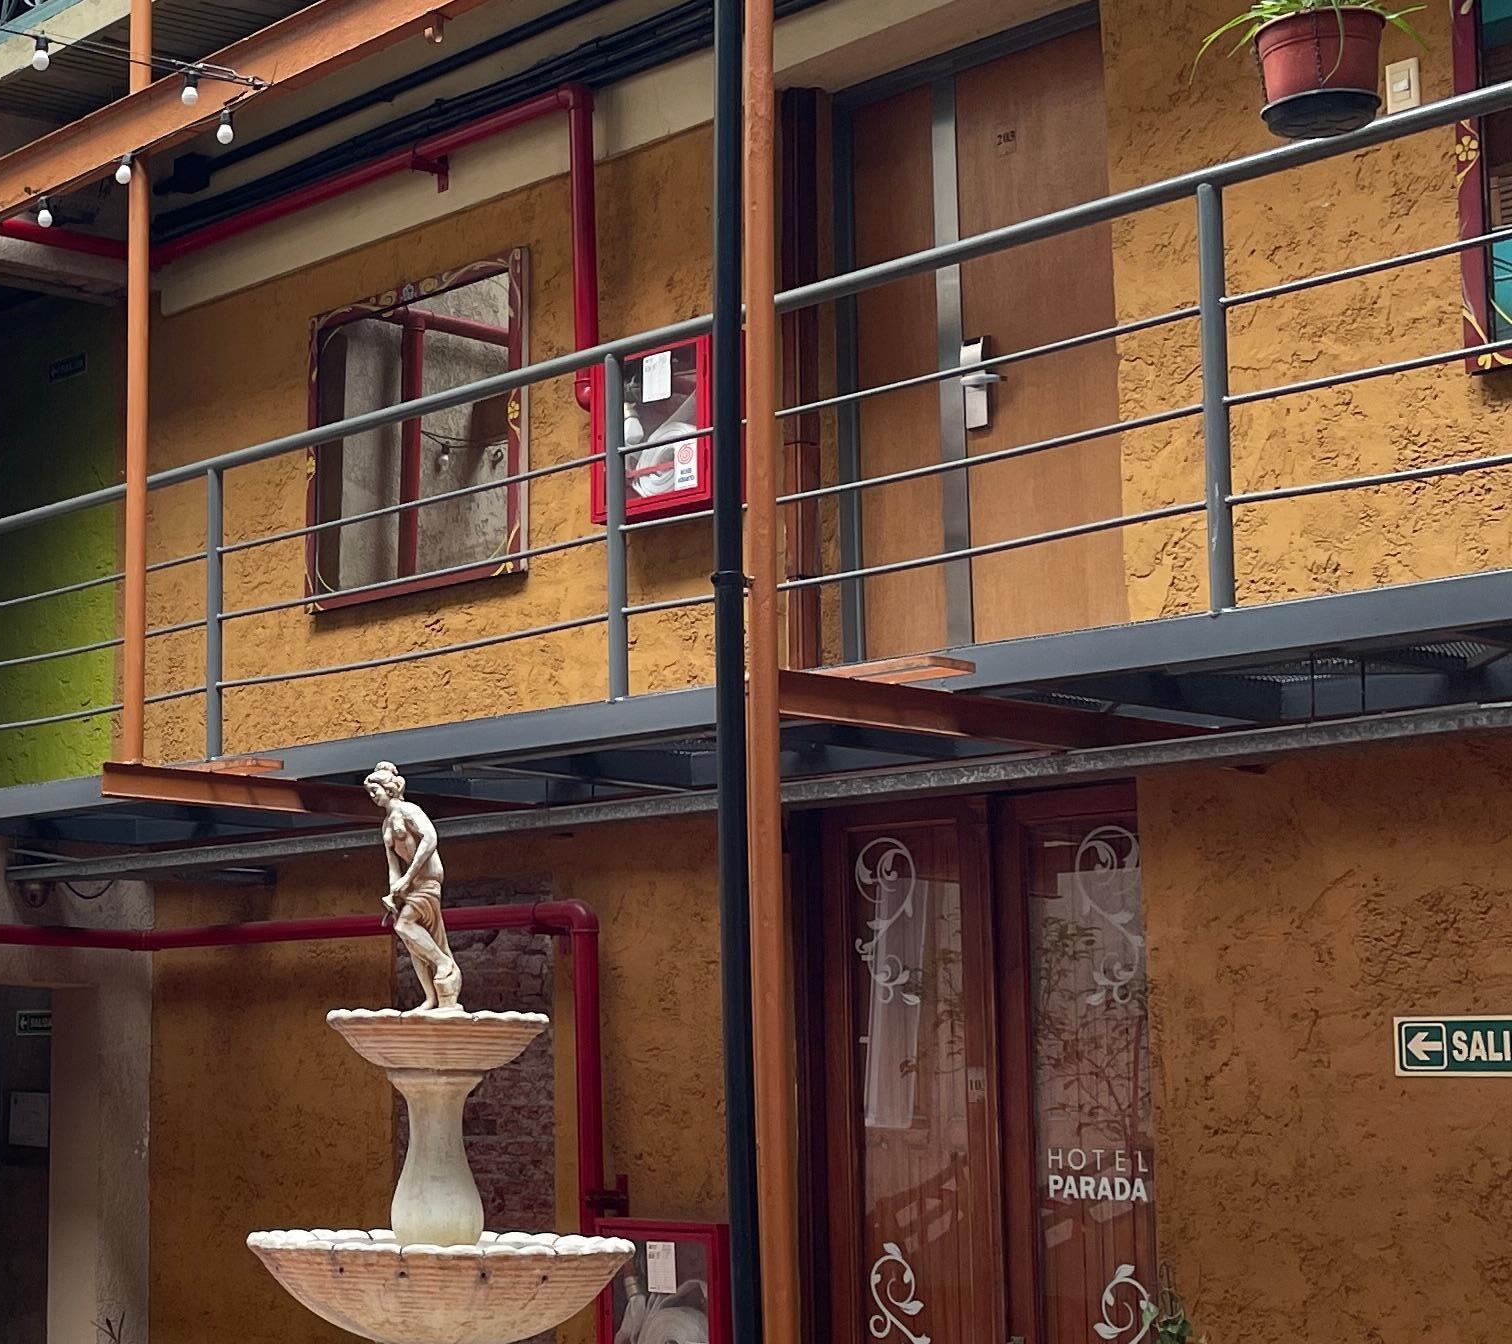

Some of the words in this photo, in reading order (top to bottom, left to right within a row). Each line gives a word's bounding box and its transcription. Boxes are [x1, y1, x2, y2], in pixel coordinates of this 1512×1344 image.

[1451, 1030, 1511, 1062] SALI
[1047, 1147, 1149, 1173] HOTEL
[1048, 1174, 1149, 1203] PARADA
